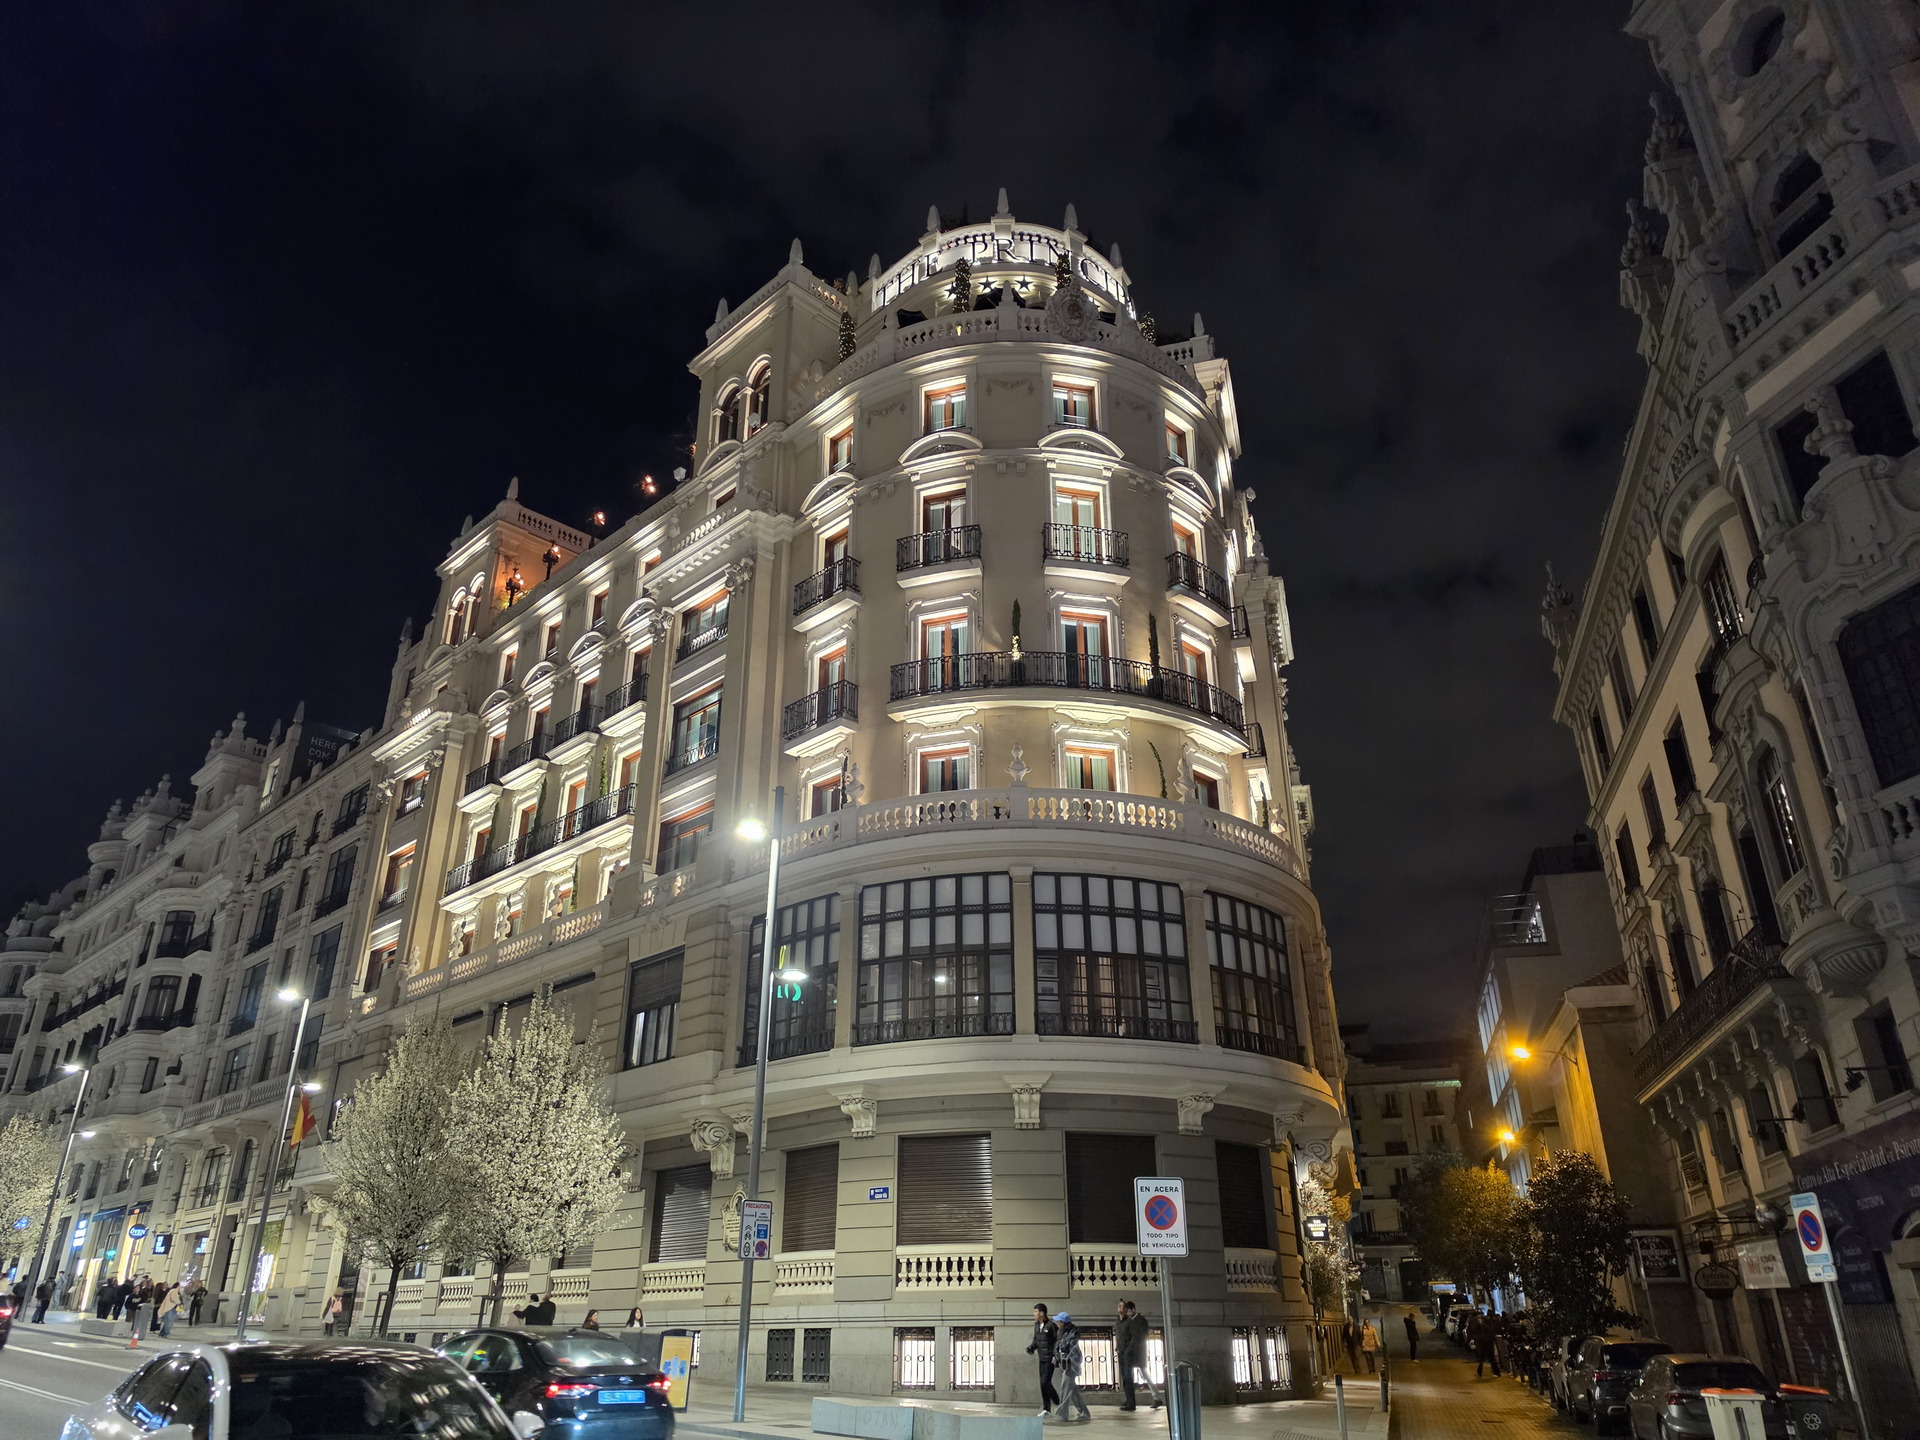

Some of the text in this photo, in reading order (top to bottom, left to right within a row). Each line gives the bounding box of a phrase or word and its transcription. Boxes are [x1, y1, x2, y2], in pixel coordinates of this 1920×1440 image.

[876, 238, 1136, 318] THE PRINCIP
[310, 736, 338, 751] HERE
[308, 747, 331, 760] COM
[1821, 1165, 1837, 1183] Alta
[1834, 1145, 1887, 1181] Especialidad
[863, 1410, 899, 1429] OTAN
